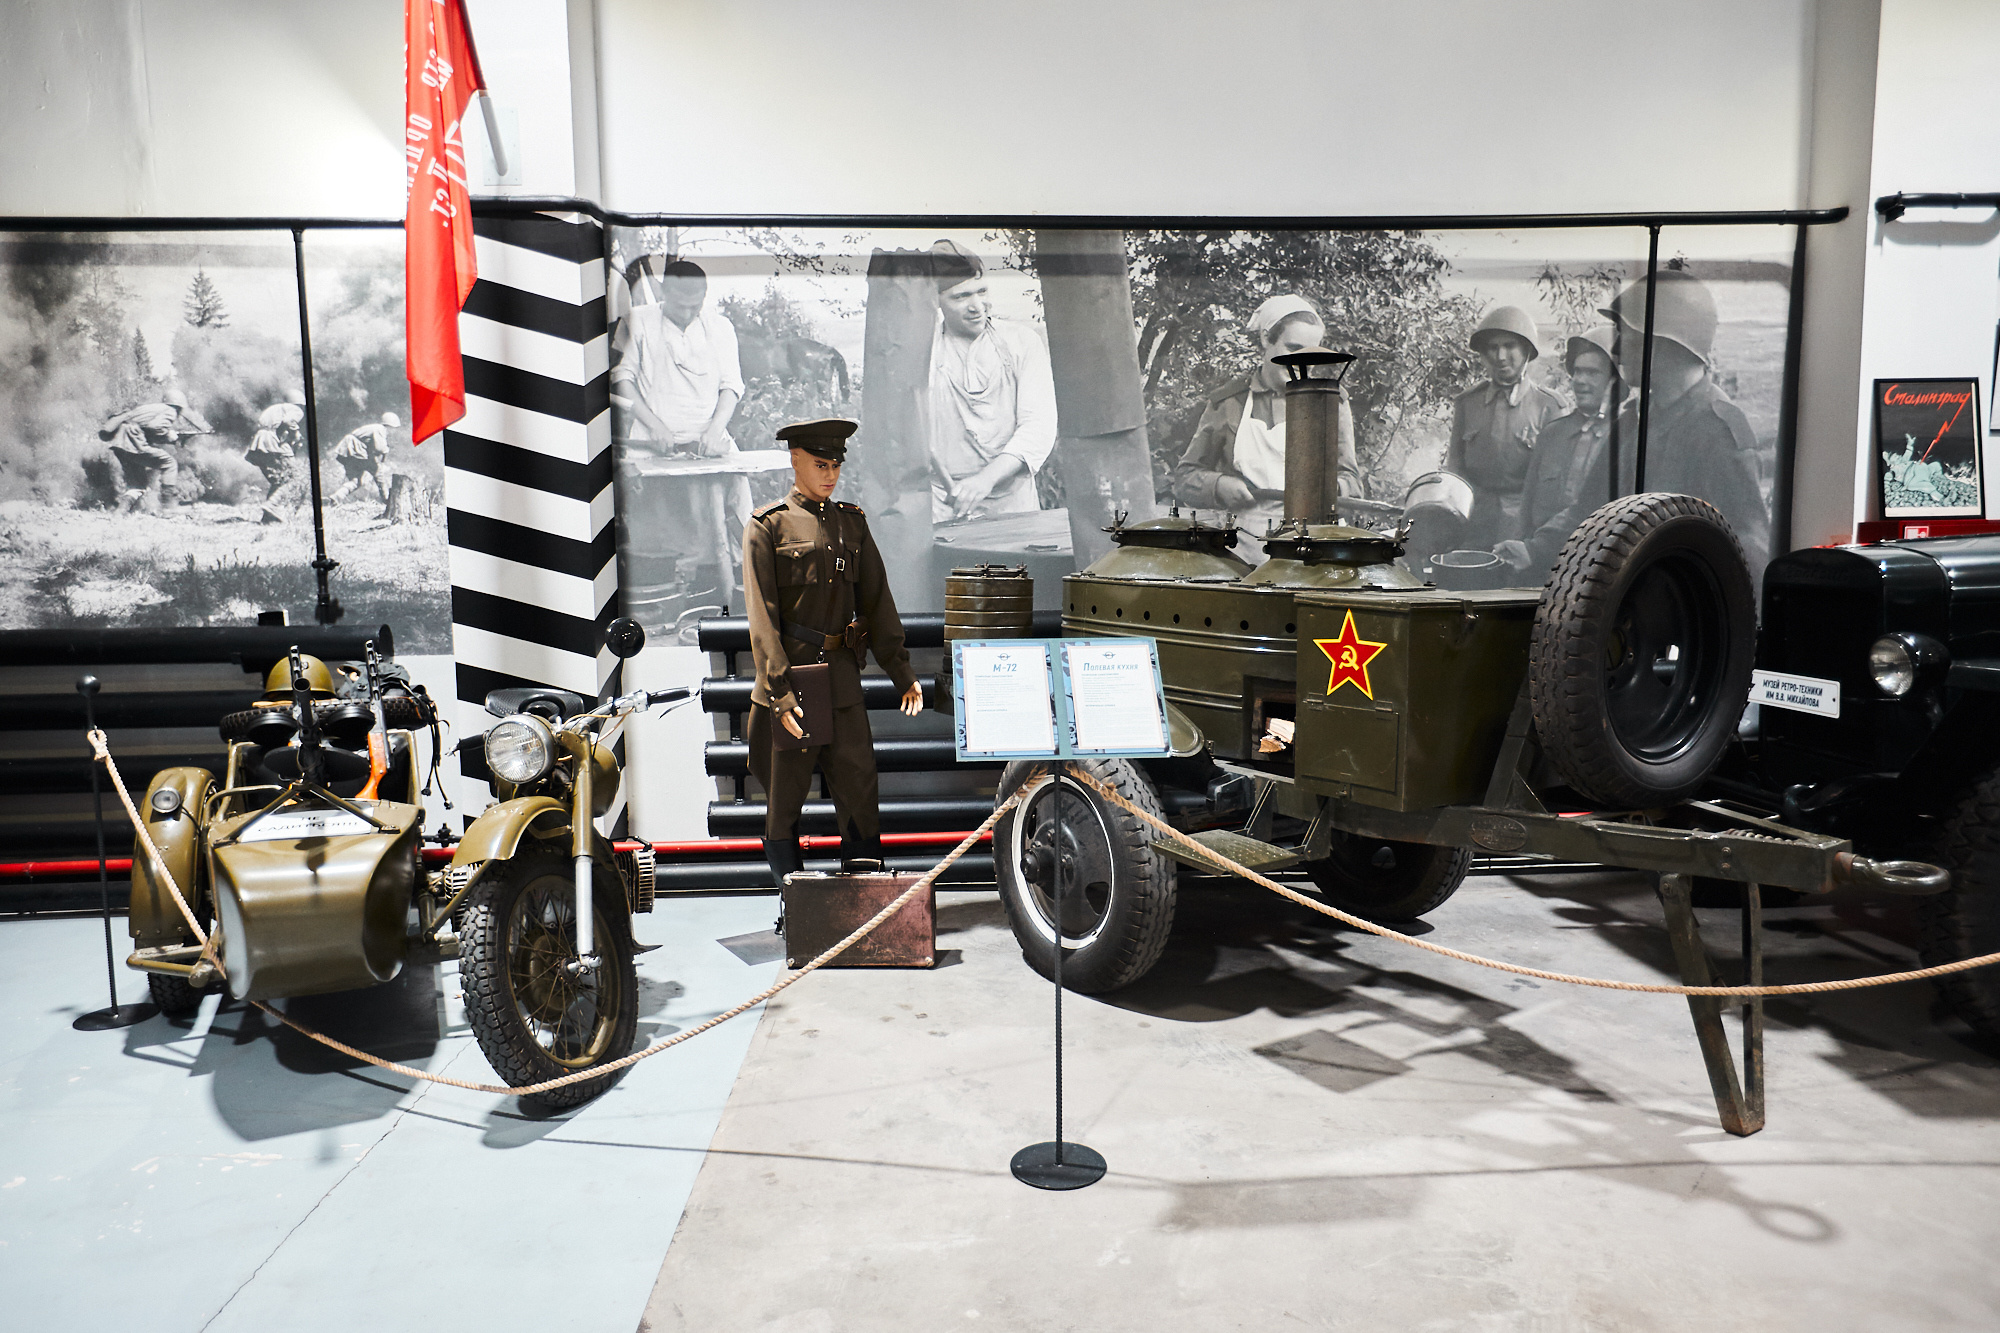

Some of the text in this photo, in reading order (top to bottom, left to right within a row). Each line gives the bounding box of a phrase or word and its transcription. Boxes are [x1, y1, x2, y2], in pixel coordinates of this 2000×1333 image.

[1883, 383, 1972, 411] Сталинград
[993, 663, 1017, 672] М-72
[1762, 679, 1823, 696] МУЗЕЙ РЕТРО-ТЕХНИКИ
[1786, 694, 1820, 708] МИХАЙЛОВА
